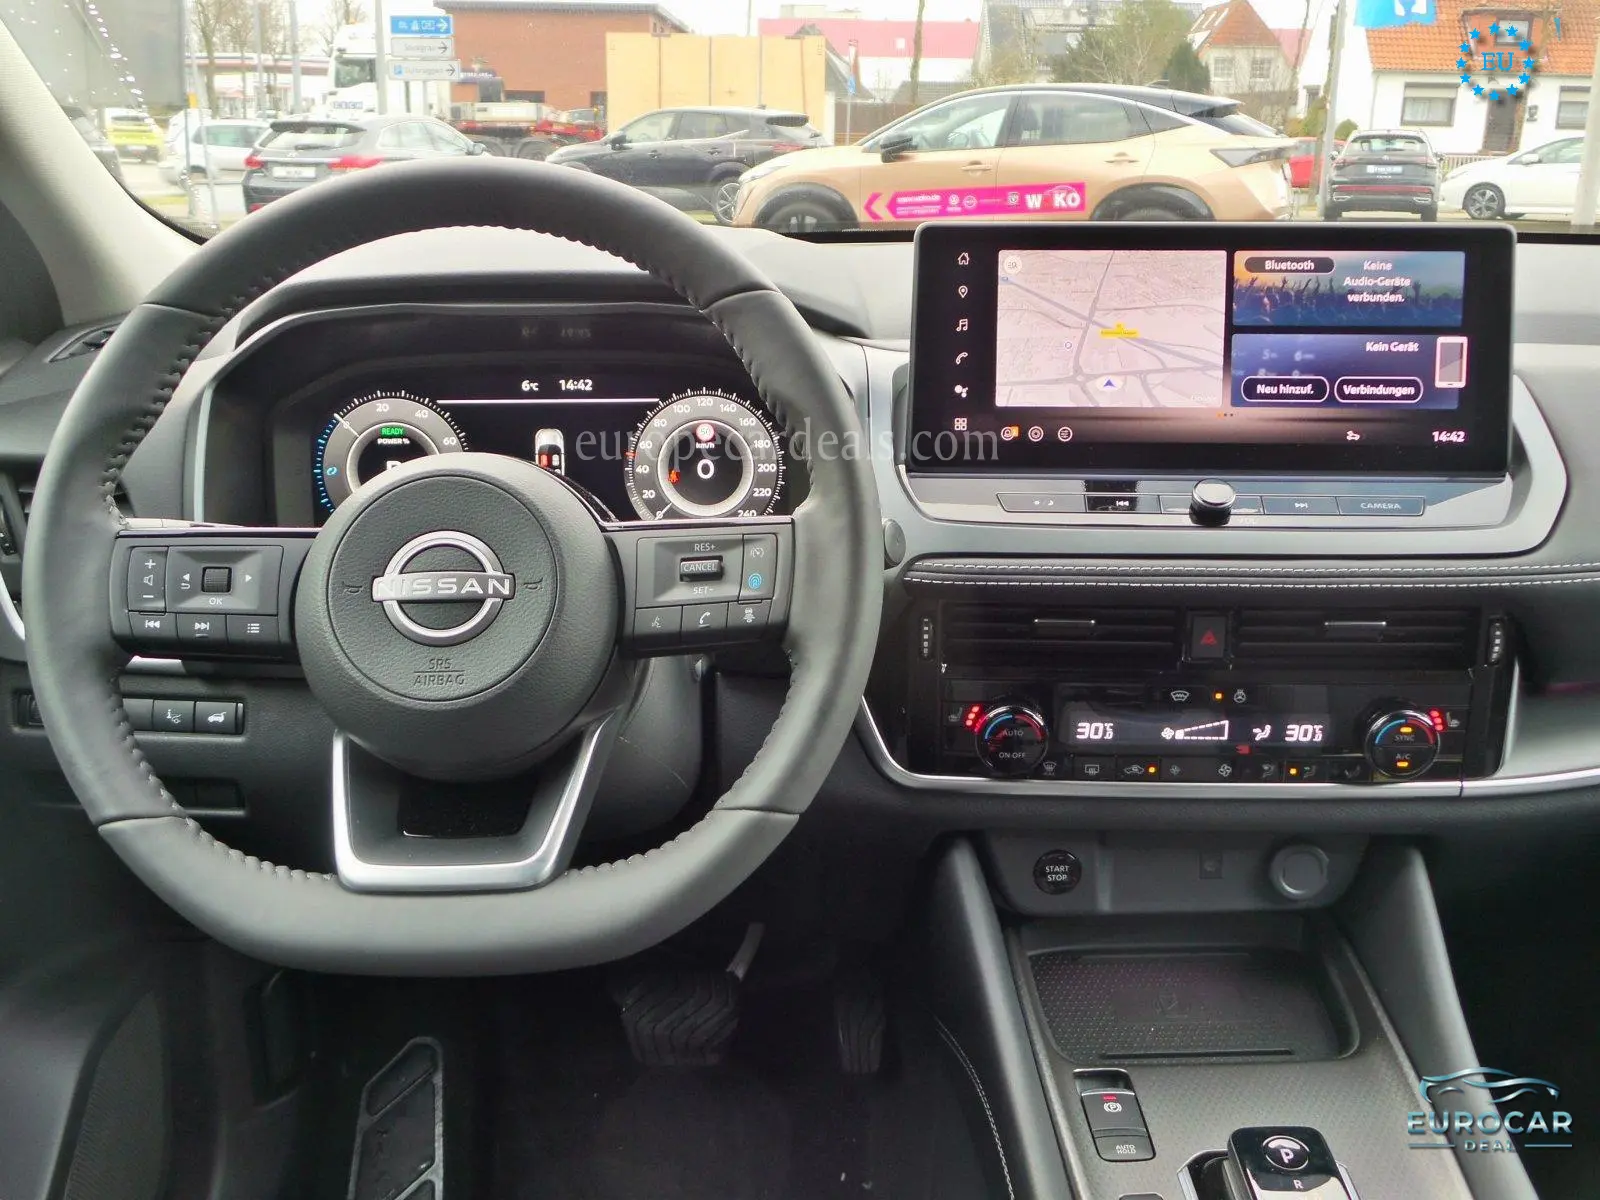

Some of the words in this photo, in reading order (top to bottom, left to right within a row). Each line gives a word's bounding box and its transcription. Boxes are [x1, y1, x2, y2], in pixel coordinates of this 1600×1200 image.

[1264, 260, 1315, 271] Bluetooth
[1363, 260, 1393, 271] Keine
[1343, 276, 1411, 288] Audio-Geräte
[1347, 292, 1405, 303] verbunden.
[1365, 341, 1388, 352] Kein
[1390, 341, 1419, 352] Gerät
[559, 379, 593, 391] 14:42
[1256, 383, 1276, 395] Neu
[1279, 383, 1314, 396] hinzuf.
[1343, 384, 1415, 398] Verbindungen
[375, 403, 390, 413] 20
[697, 399, 713, 407] 120
[720, 404, 737, 412] 140
[414, 409, 429, 418] 40
[673, 404, 691, 413] 100
[653, 418, 667, 427] 80
[739, 417, 756, 426] 160
[381, 427, 404, 436] READY
[1431, 430, 1466, 443] 14:42
[443, 436, 457, 446] 60
[639, 440, 653, 449] 60
[753, 439, 771, 448] 180
[636, 464, 650, 474] 40
[696, 458, 715, 480] 0
[757, 463, 777, 473] 200
[642, 489, 656, 499] 20
[753, 487, 772, 497] 220
[1360, 502, 1401, 510] CAMERA
[694, 543, 716, 552] RES+
[683, 563, 716, 572] CANCEL
[377, 578, 511, 597] NISSAN
[208, 597, 223, 606] OK
[428, 658, 452, 670] SRS
[413, 674, 466, 687] AIRBAG
[1394, 734, 1416, 742] SYNC
[1395, 752, 1411, 761] A/C
[1045, 865, 1070, 873] START
[1047, 874, 1068, 882] STOP
[1280, 1148, 1294, 1164] P
[1293, 1180, 1304, 1189] R
